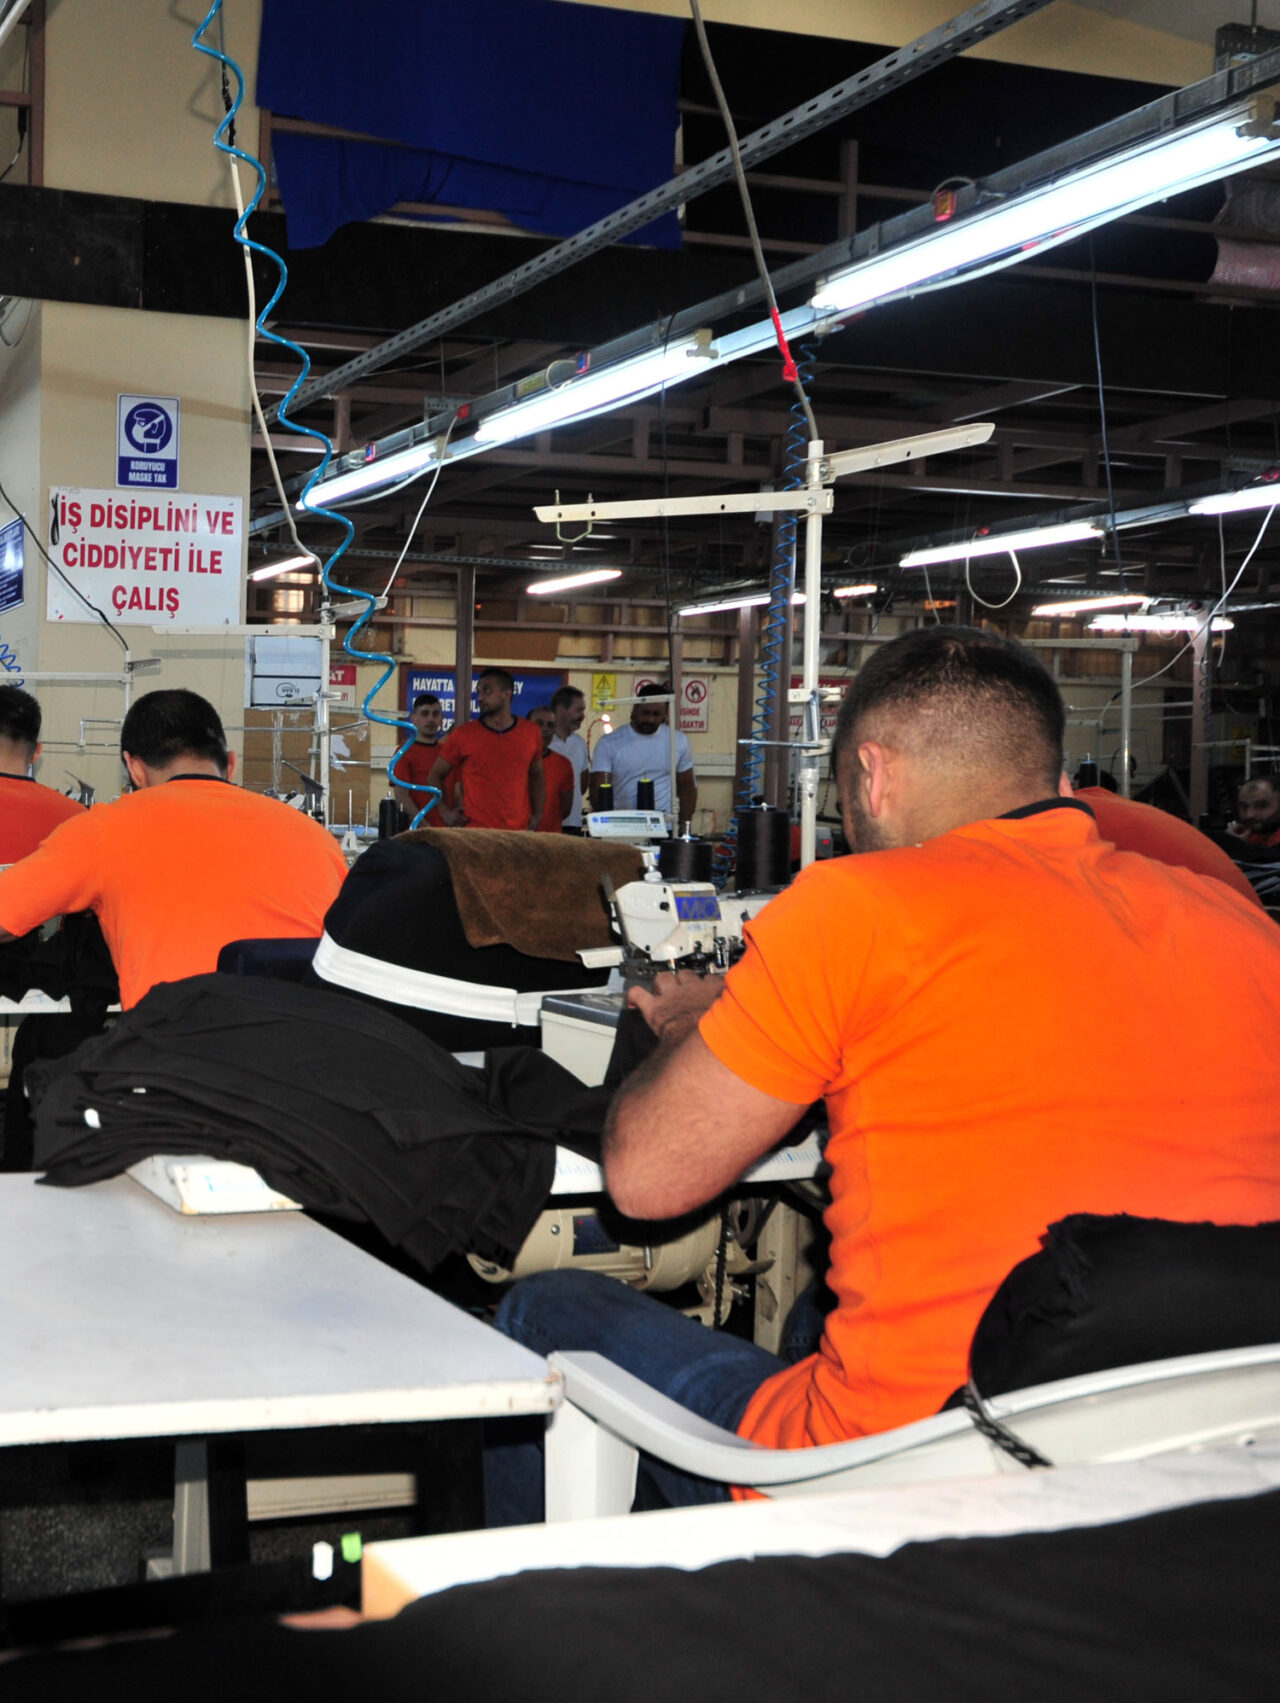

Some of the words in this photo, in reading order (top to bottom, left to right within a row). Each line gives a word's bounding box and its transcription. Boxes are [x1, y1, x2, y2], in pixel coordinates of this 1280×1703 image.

[128, 472, 153, 482] MASKE
[154, 473, 167, 483] TAK
[130, 461, 165, 472] KORUYUCU
[60, 495, 82, 534] İŞ
[90, 498, 197, 533] DİSİPLİNİ
[206, 510, 234, 535] VE
[62, 537, 180, 572] CİDDİYETİ
[188, 542, 223, 574] İLE
[111, 585, 180, 618] ÇALIŞ
[413, 678, 454, 692] HAYATTA
